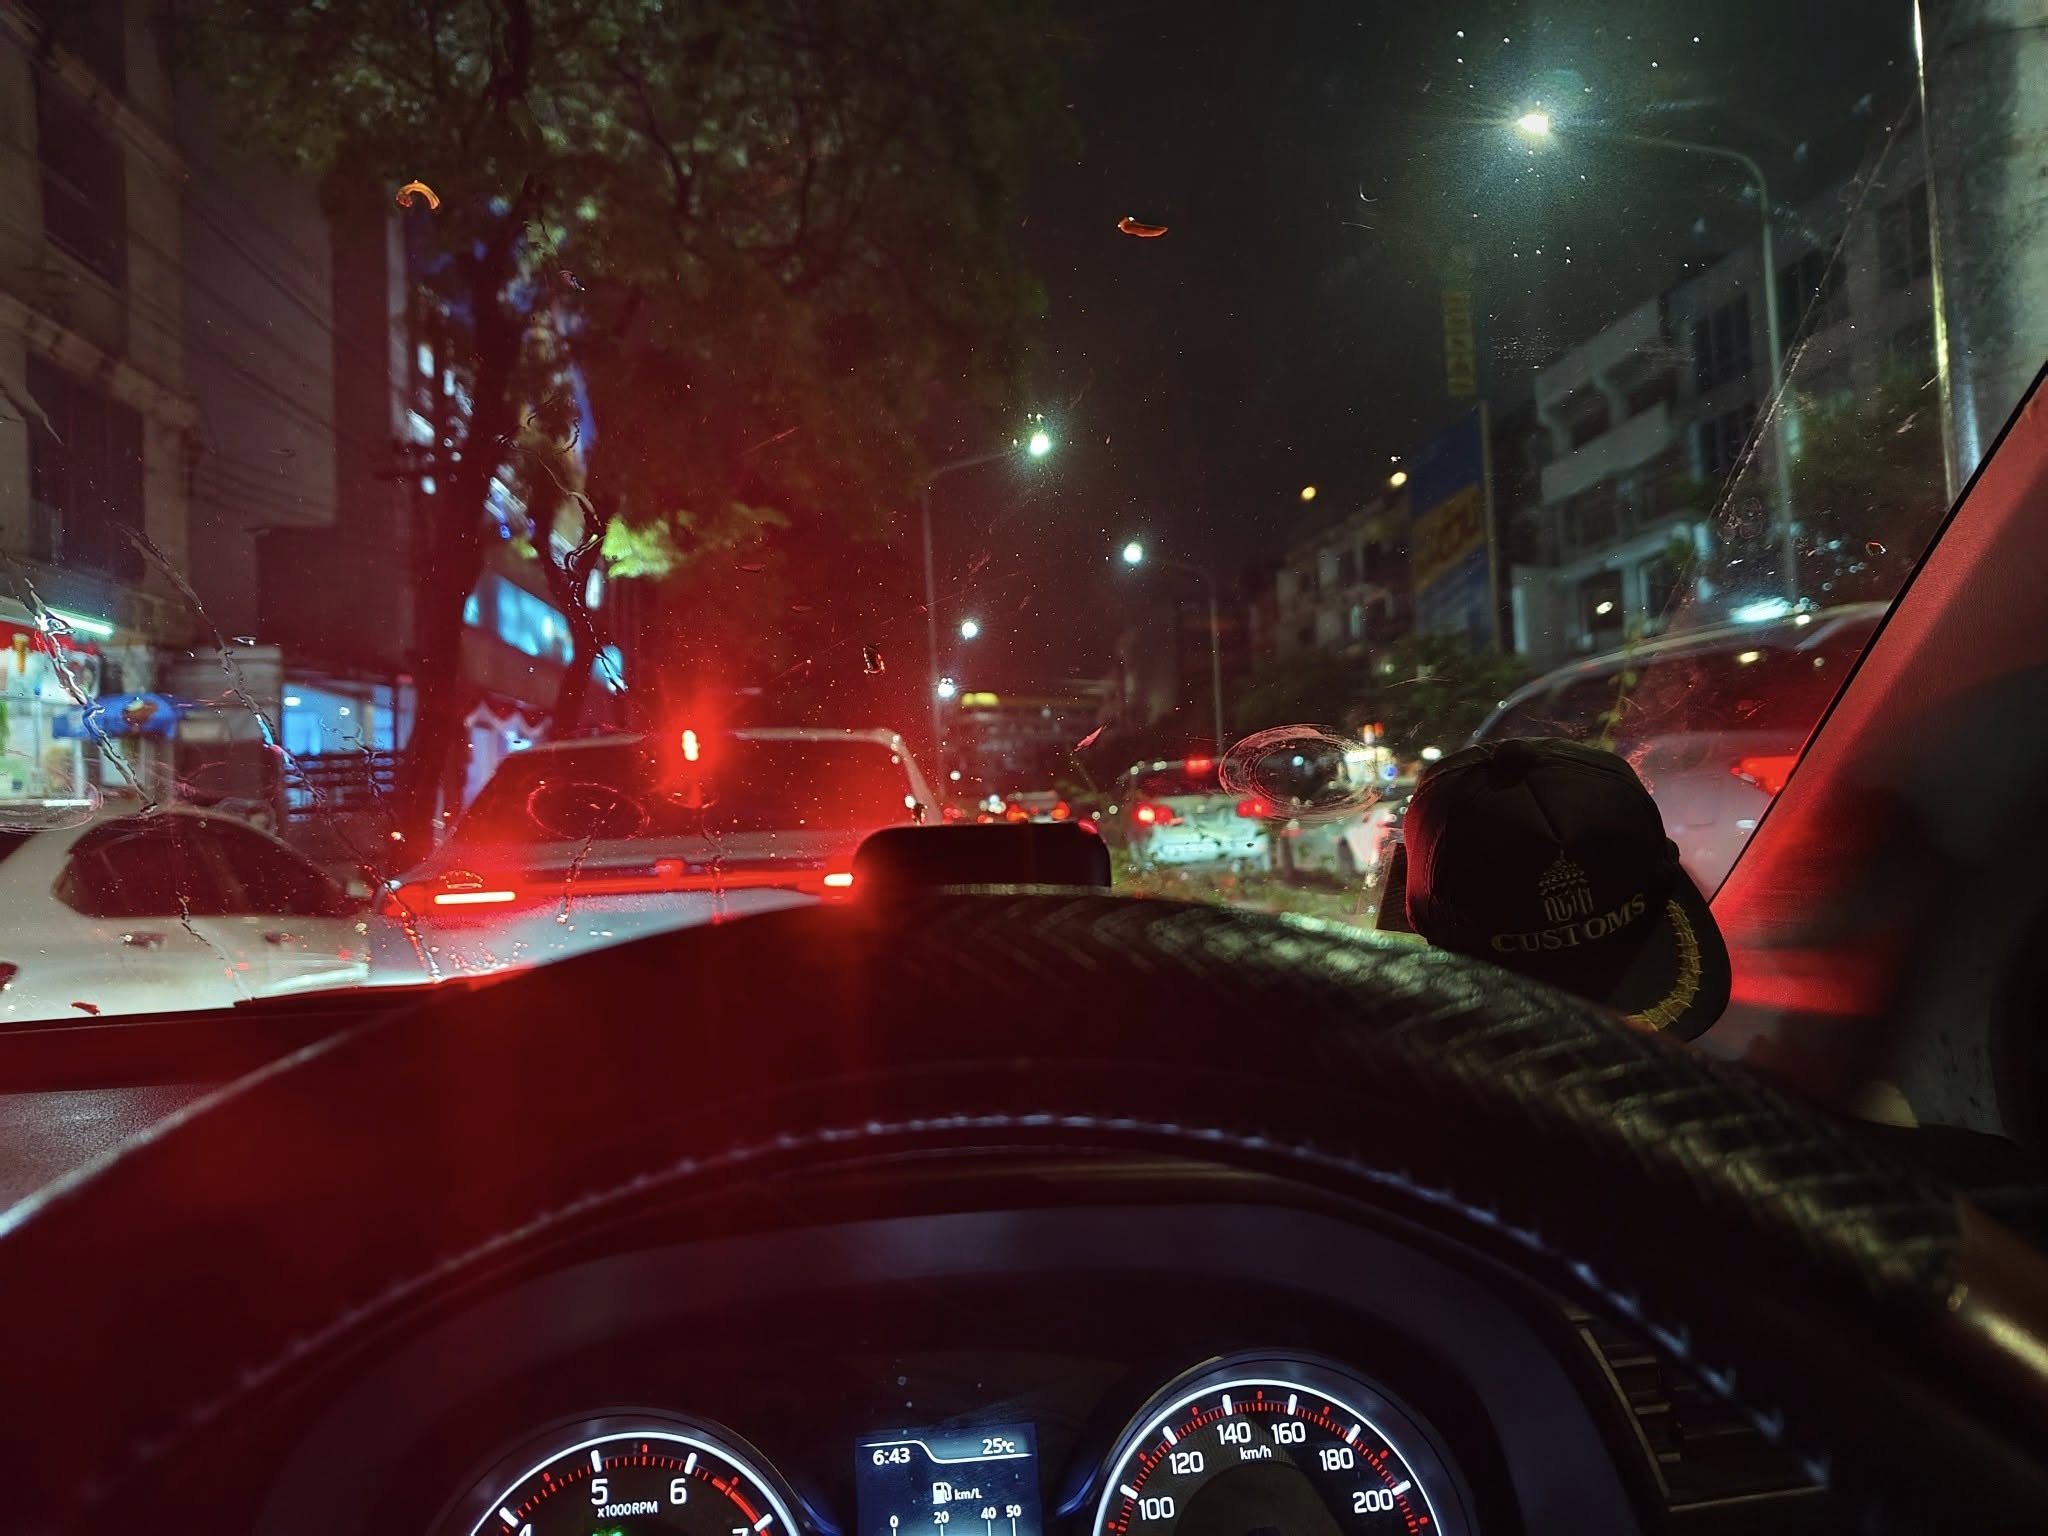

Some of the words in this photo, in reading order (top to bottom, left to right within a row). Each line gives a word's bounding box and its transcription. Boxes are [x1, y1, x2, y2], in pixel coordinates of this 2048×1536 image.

[1491, 893, 1647, 952] CUSTOMS
[1217, 1422, 1252, 1445] 140
[1271, 1422, 1306, 1445] 160
[873, 1448, 911, 1466] 6:43
[1169, 1451, 1204, 1474] 120
[1240, 1445, 1272, 1460] km/h
[1319, 1447, 1354, 1471] 180
[591, 1478, 608, 1505] 5
[670, 1478, 687, 1505] 6
[954, 1488, 983, 1501] km/L
[1353, 1489, 1394, 1514] 200
[889, 1515, 899, 1528] 0
[934, 1511, 950, 1524] 20
[980, 1507, 997, 1520] 40
[1005, 1504, 1022, 1518] 50
[1138, 1496, 1175, 1520] 100
